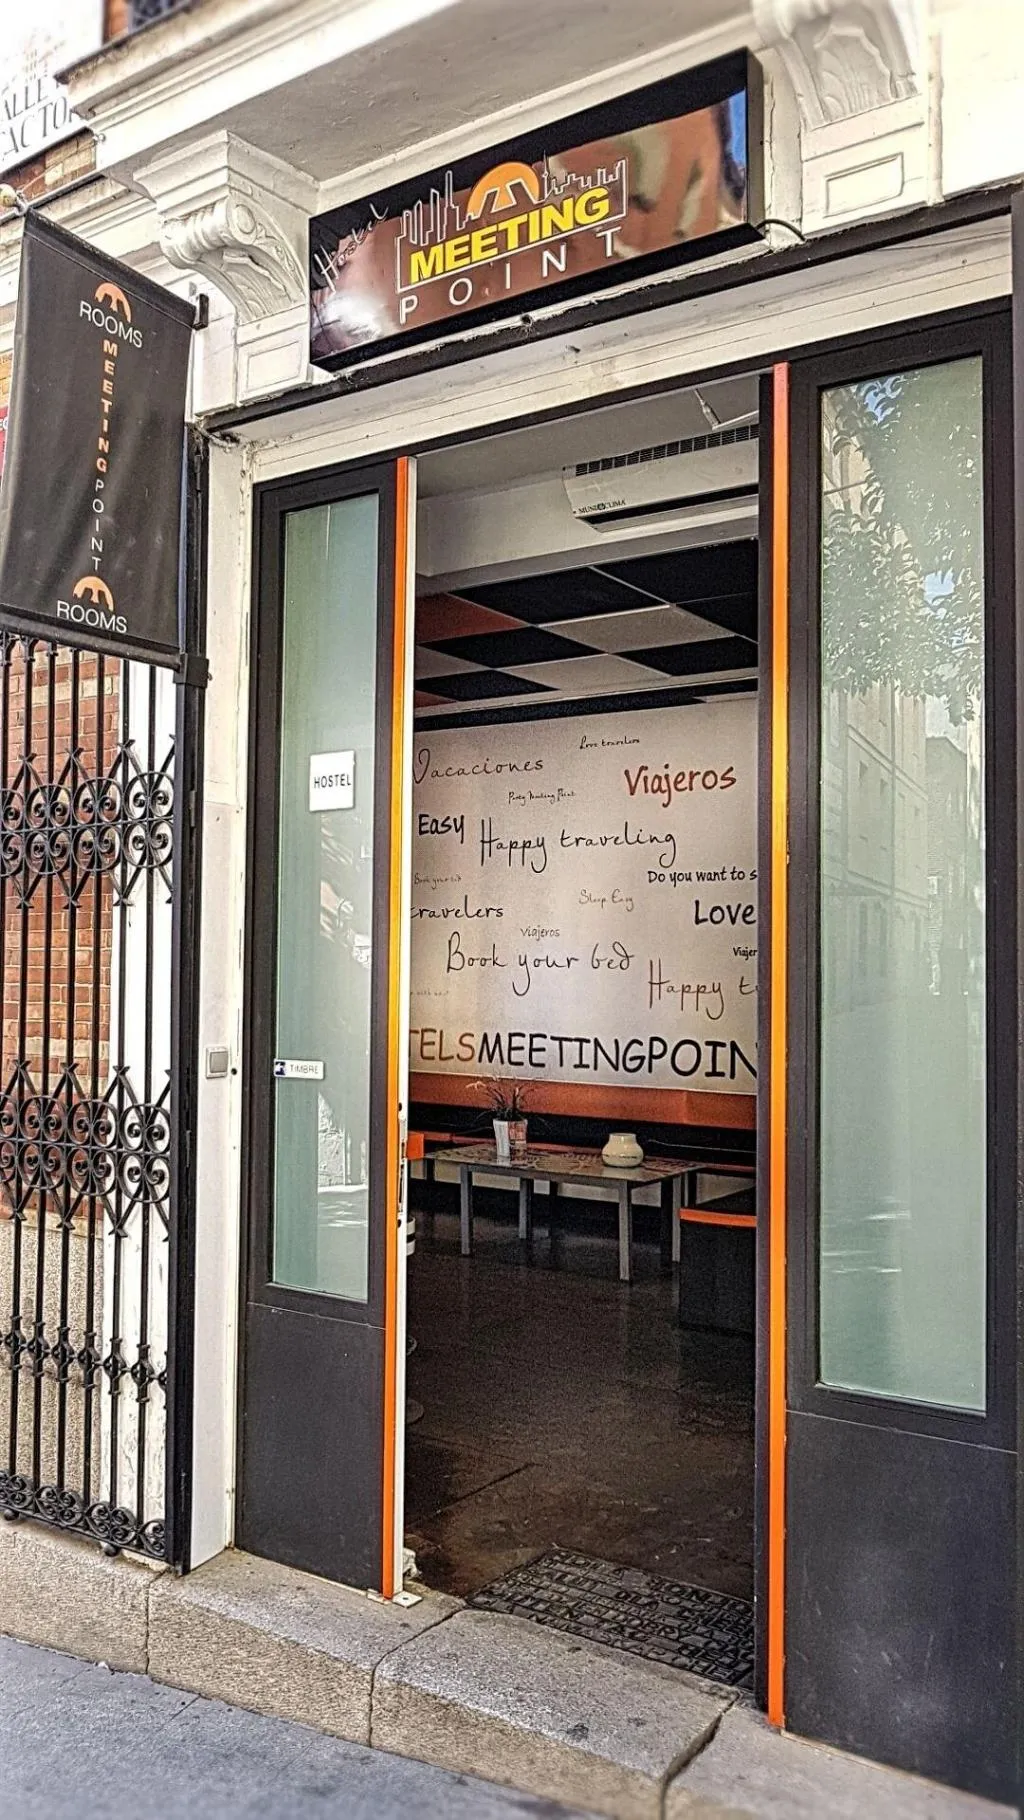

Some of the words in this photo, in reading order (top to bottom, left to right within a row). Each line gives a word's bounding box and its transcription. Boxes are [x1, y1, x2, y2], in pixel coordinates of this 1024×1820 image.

[314, 203, 390, 293] Hostel
[409, 186, 611, 284] MEETING
[400, 227, 621, 324] POINT
[79, 301, 143, 348] ROOMS
[96, 339, 118, 473] MEETING
[91, 479, 105, 571] POINT
[56, 600, 127, 634] ROOMS
[314, 773, 352, 788] HOSTEL
[413, 748, 545, 784] Vacaciones
[624, 763, 737, 808] Viajeros
[418, 813, 465, 843] Easy
[480, 817, 547, 873] Happy
[560, 821, 677, 868] traveling
[647, 870, 666, 883] Do
[669, 871, 692, 888] you
[696, 866, 728, 882] want
[730, 866, 746, 880] to
[694, 899, 757, 926] Love
[446, 931, 506, 974] Book
[512, 950, 579, 997] your
[590, 941, 636, 971] bed
[648, 957, 725, 1021] Happy
[290, 1063, 319, 1075] TIMBRE
